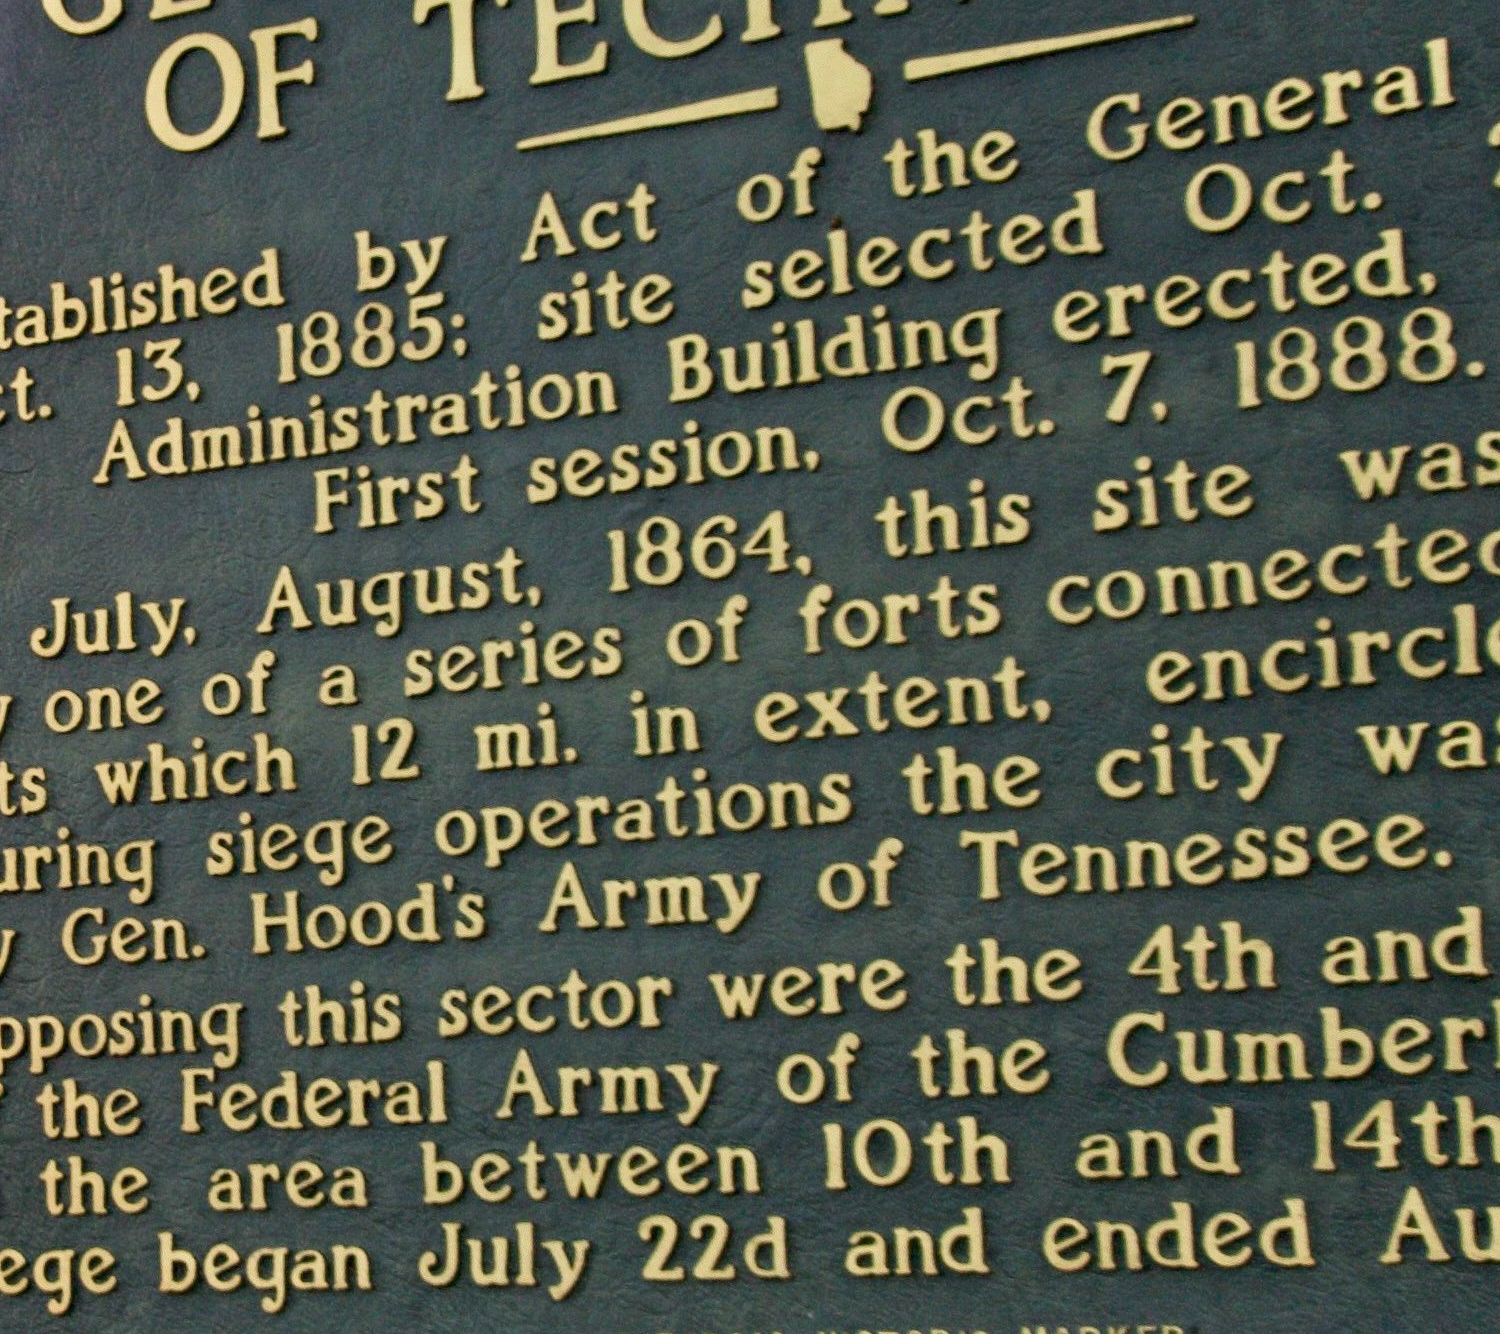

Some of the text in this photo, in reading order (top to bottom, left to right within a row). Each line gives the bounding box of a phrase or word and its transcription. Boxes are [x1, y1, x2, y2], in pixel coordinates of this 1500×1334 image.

[143, 16, 319, 153] OF
[353, 228, 448, 297] by
[518, 181, 658, 263] Act
[735, 145, 822, 223] of
[882, 127, 1019, 198] the
[1085, 36, 1456, 161] General
[91, 363, 618, 485] Administration
[666, 303, 1002, 403] Building
[1051, 227, 1437, 343] erected,
[114, 336, 201, 408] 13,
[275, 290, 468, 384] 1885;
[536, 269, 675, 341] site
[740, 187, 1104, 310] selected
[1184, 148, 1383, 233] Oct.
[312, 305, 1486, 535] First session, Oct. 7, 1888.
[28, 589, 197, 659] July,
[254, 545, 542, 638] August,
[606, 509, 813, 593] 1864,
[873, 477, 1031, 559] this
[1091, 454, 1254, 532] site
[42, 677, 165, 734] one
[200, 648, 276, 717] of
[316, 663, 358, 707] a
[402, 619, 623, 698] series
[665, 593, 749, 667] of
[797, 574, 1002, 654] forts
[93, 731, 298, 805] which
[349, 716, 420, 787] 12
[472, 700, 578, 772] mi.
[628, 688, 701, 757] in
[753, 655, 1053, 744] extent,
[204, 810, 394, 887] siege
[433, 766, 853, 869] operations
[900, 744, 1042, 816] the
[1095, 722, 1284, 803] city
[60, 905, 206, 966] Gen.
[248, 872, 486, 955] Hood's
[537, 860, 762, 934] Army
[816, 836, 905, 911] of
[958, 812, 1453, 901] Tennessee.
[277, 978, 402, 1048] this
[437, 968, 673, 1038] sector
[707, 957, 908, 1020] were
[943, 936, 1083, 1007] the
[1126, 919, 1277, 995] 4th
[1320, 904, 1490, 985] and
[34, 1076, 142, 1140] the
[179, 1059, 449, 1134] Federal
[494, 1047, 720, 1127] Army
[775, 1030, 861, 1105] of
[909, 1026, 1051, 1099] the
[38, 1154, 149, 1217] the
[207, 1159, 369, 1212] area
[419, 1139, 762, 1205] between
[821, 1114, 1012, 1191] 10th
[1074, 1105, 1242, 1179] and
[156, 1230, 372, 1315] began
[417, 1220, 591, 1301] July
[636, 1213, 792, 1282] 22d
[843, 1205, 991, 1277] and
[1041, 1196, 1316, 1272] ended
